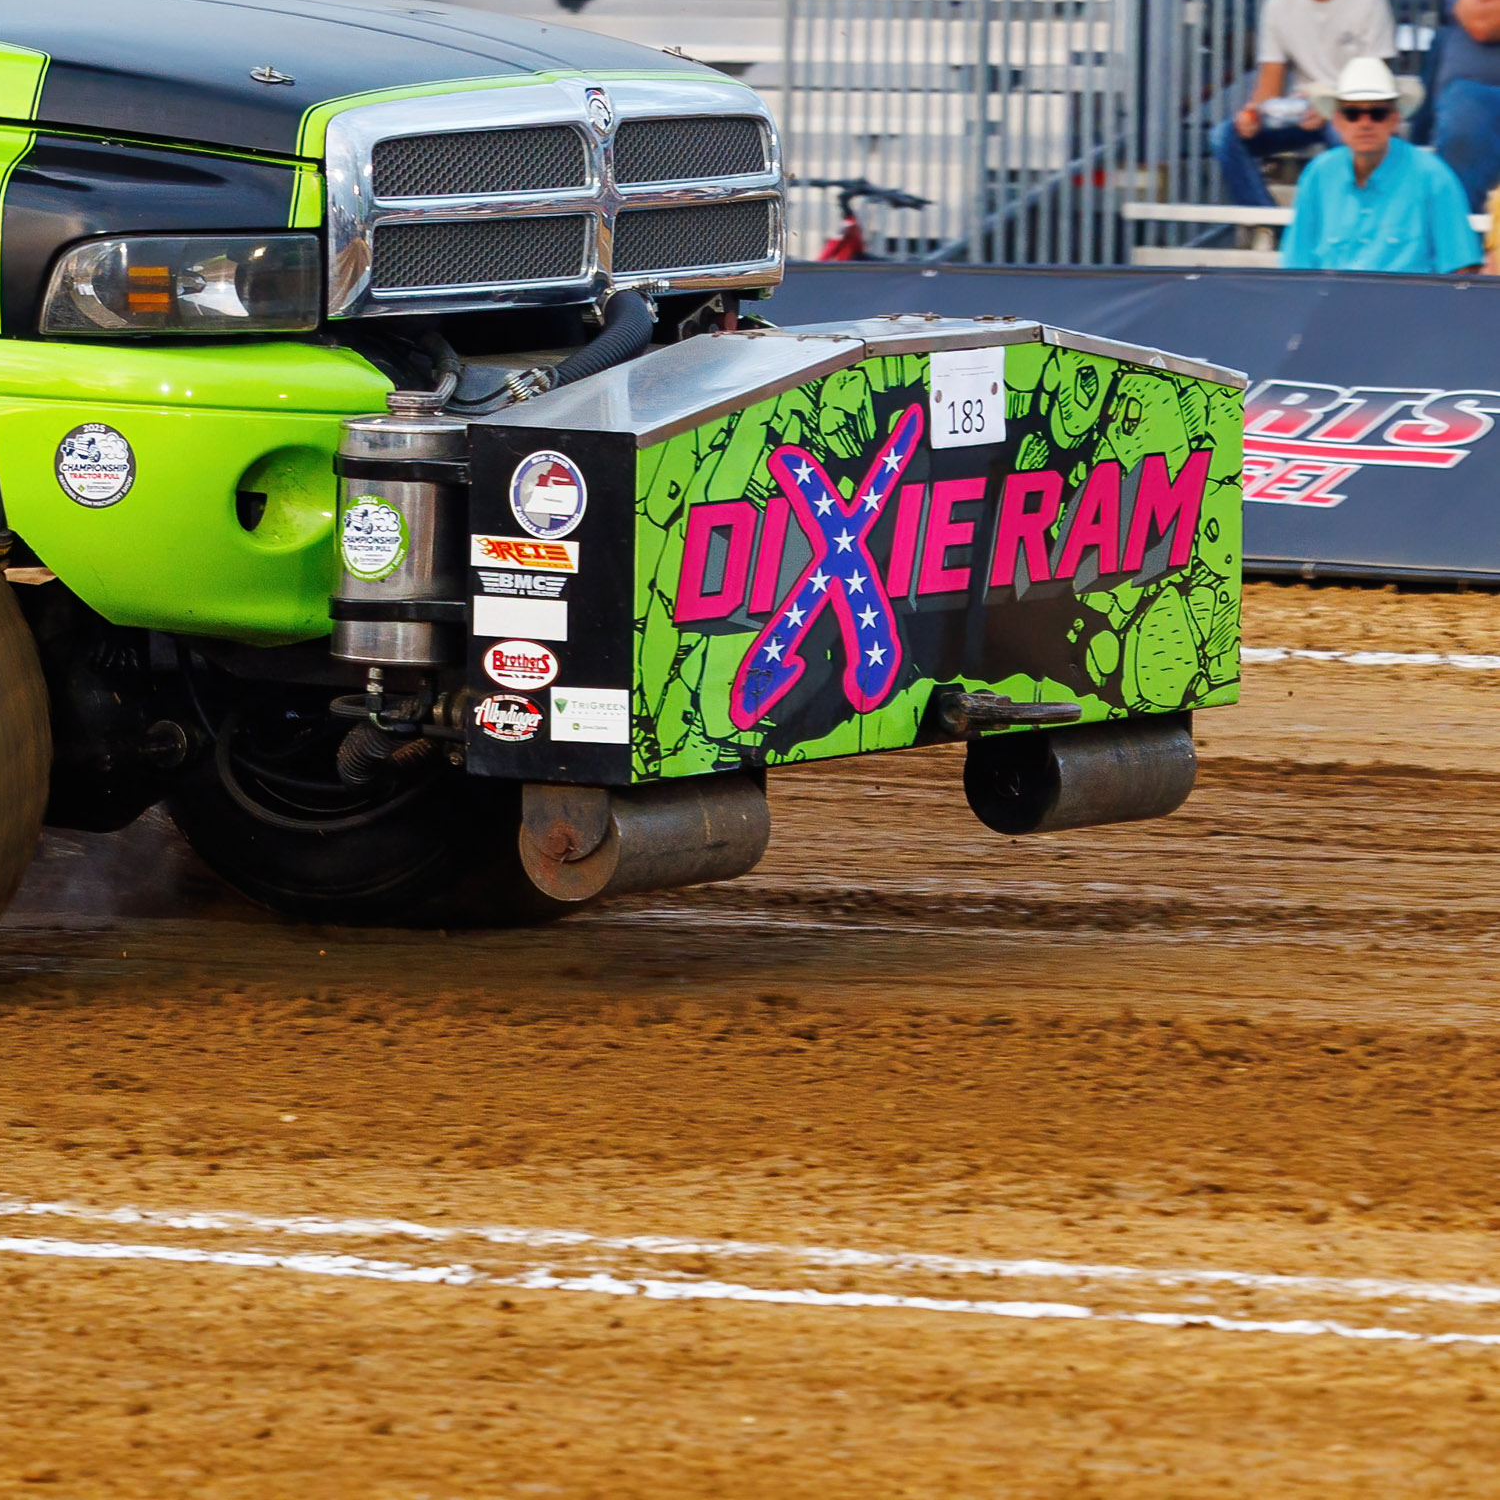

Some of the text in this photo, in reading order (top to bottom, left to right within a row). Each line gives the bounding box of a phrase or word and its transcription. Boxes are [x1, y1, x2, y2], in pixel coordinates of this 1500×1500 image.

[948, 399, 985, 435] 183
[1243, 379, 1500, 447] RTS
[82, 423, 106, 432] 2025
[61, 463, 128, 472] CHAMPIONSHIP
[343, 535, 400, 544] CHAMPIONSHIP
[673, 402, 1212, 731] DIXIE RAM
[499, 573, 546, 590] BMC
